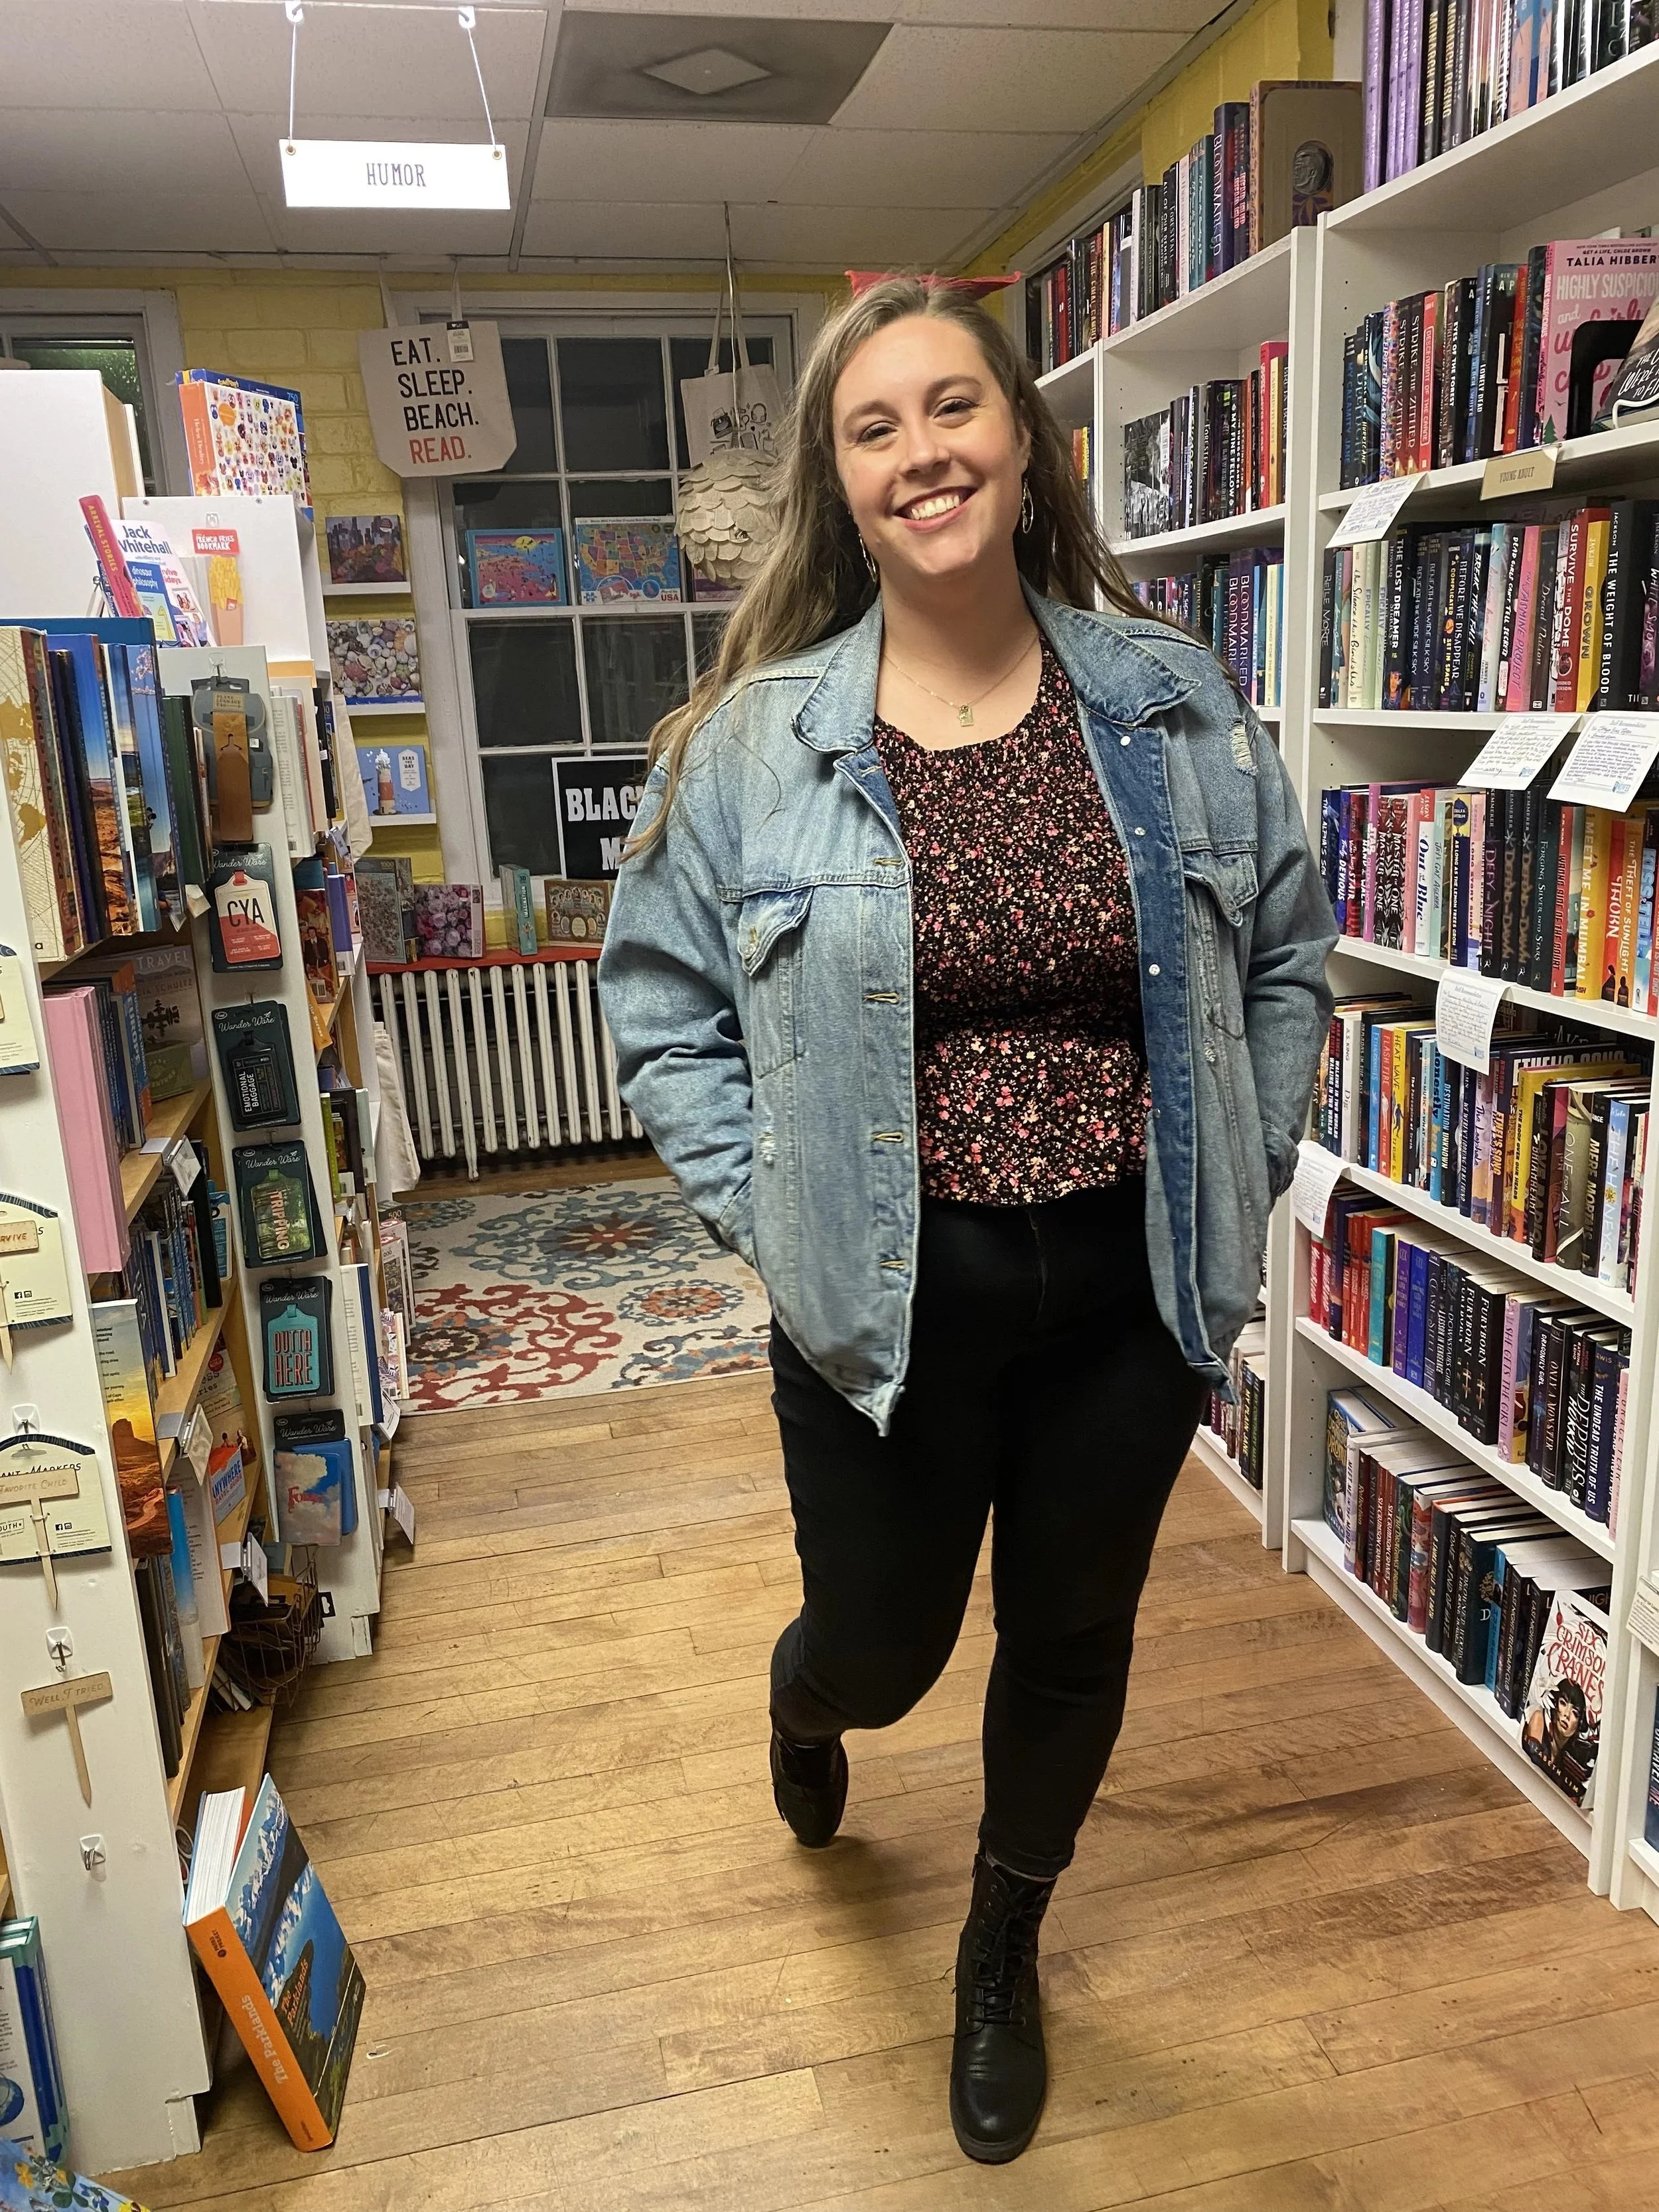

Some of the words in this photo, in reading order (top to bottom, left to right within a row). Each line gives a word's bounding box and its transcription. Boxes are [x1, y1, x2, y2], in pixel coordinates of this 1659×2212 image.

[1427, 11, 1438, 78] MONARCH
[1445, 1, 1457, 72] MONARCH
[1424, 80, 1435, 127] RISING
[1443, 72, 1453, 119] RISING
[366, 163, 426, 186] HUMOR
[1212, 134, 1222, 256] BLOODMARKED
[1567, 257, 1605, 266] TALIA
[1557, 274, 1600, 300] HIGHLY
[1602, 272, 1659, 298] SUSPICIO
[1541, 299, 1550, 337] SUSPICIOUS
[1558, 304, 1581, 324] and
[391, 338, 440, 366] EAT.
[1636, 352, 1652, 368] THE
[398, 370, 472, 398] SLEEP.
[1618, 368, 1653, 397] WE'RE
[1633, 386, 1645, 399] TO
[403, 402, 478, 431] BEACH.
[1231, 411, 1237, 429] MY
[409, 435, 471, 465] READ.
[1500, 469, 1517, 483] YOUNG
[1518, 467, 1534, 479] ADULT
[88, 504, 104, 538] ARRIVAL
[101, 538, 117, 572] STORIES
[123, 526, 151, 539] Jack
[196, 535, 218, 544] FRENCH
[197, 542, 230, 551] BOOKMARK
[1395, 539, 1404, 561] THE
[1566, 524, 1579, 584] SURVIVE
[1609, 551, 1619, 574] THE
[132, 567, 152, 576] dinosaur
[133, 578, 159, 590] philosophy
[1394, 564, 1403, 592] LOST
[1457, 560, 1468, 601] BEFORE
[1473, 552, 1481, 591] BREAK
[1323, 574, 1333, 604] BELLE
[1540, 582, 1551, 621] Dread
[1605, 579, 1617, 628] WEIGHT
[1392, 595, 1402, 648] DREAMER
[1455, 604, 1464, 619] WE
[1561, 606, 1572, 648] DOME
[1581, 586, 1594, 659] GROWN
[1239, 575, 1250, 687] BLOODMARKED
[1321, 609, 1332, 647] MORTE
[1468, 618, 1477, 645] FALL
[1603, 632, 1613, 648] OF
[1451, 622, 1463, 679] DISAPPEAR
[1537, 625, 1548, 665] Nation
[1600, 653, 1611, 694] BLOOD
[1377, 832, 1386, 875] MASTER
[1391, 834, 1400, 877] MASTER
[1419, 838, 1430, 871] Out
[1583, 824, 1594, 863] MEET
[1484, 849, 1498, 891] DEFY
[1538, 840, 1548, 880] FORGING
[1640, 848, 1656, 899] KISS
[1337, 859, 1347, 901] DEVIOUS
[1581, 869, 1591, 891] ME
[1624, 859, 1637, 900] THEFT
[227, 898, 265, 927] CYA
[520, 886, 528, 918] IMAGINATION
[1375, 885, 1384, 913] ONE
[1390, 887, 1400, 914] ONE
[1416, 883, 1428, 921] Blue
[1537, 884, 1546, 913] SILVER
[1580, 897, 1591, 915] IN
[1606, 875, 1623, 938] THORN
[1626, 902, 1632, 914] OF
[1483, 899, 1499, 955] NIGHT
[1638, 901, 1653, 947] TELL
[137, 950, 190, 970] TRAVEL
[1534, 934, 1543, 962] STARS
[1577, 919, 1590, 980] MUMBAI
[1619, 916, 1631, 974] SUNLIGHT
[155, 978, 194, 994] SCHULTZ
[126, 995, 141, 1065] EUROPE
[219, 1019, 252, 1031] Wander
[252, 1016, 275, 1025] Ware
[1382, 1035, 1391, 1067] FLASH
[239, 1071, 252, 1112] EMOTIONAL
[247, 1073, 259, 1107] BAGGAGE
[1381, 1068, 1390, 1086] FIRE
[1442, 1083, 1451, 1131] DESTINATION
[1475, 1104, 1485, 1123] The
[1494, 1112, 1505, 1147] ETHEL'S
[246, 1157, 278, 1169] Wander
[279, 1154, 301, 1163] Ware
[1441, 1132, 1451, 1169] UNKNOWN
[1473, 1125, 1484, 1167] Loophole
[1493, 1149, 1502, 1175] SONG
[1561, 1131, 1576, 1175] ONE
[270, 1190, 289, 1250] TRIPPING
[1559, 1191, 1571, 1229] ALL
[265, 1290, 296, 1303] Wander
[297, 1289, 319, 1299] Ware
[1463, 1287, 1475, 1357] FURYBORN
[1478, 1296, 1490, 1367] FURYBORN
[1504, 1327, 1514, 1349] SHE
[273, 1329, 312, 1355] OUTTA
[1446, 1312, 1455, 1366] DOWNSTAIRS
[275, 1352, 313, 1387] HERE
[1502, 1350, 1512, 1377] GETS
[1245, 1388, 1251, 1400] MY
[1501, 1379, 1511, 1401] THE
[1595, 1384, 1605, 1401] THE
[1499, 1402, 1510, 1427] GIRL
[1593, 1403, 1603, 1441] UNDEAD
[280, 1426, 313, 1438] Wander
[314, 1424, 336, 1432] Ware
[1590, 1443, 1601, 1475] TRUTH
[1587, 1490, 1596, 1505] US
[1589, 1476, 1597, 1489] OF
[1576, 1622, 1599, 1650] SIX
[76, 1683, 104, 1696] TRIED
[1548, 1642, 1604, 1715] CRANES
[1523, 1733, 1562, 1777] ELIZABETH
[1564, 1777, 1579, 1794] LIM
[281, 1989, 292, 2015] The
[287, 1958, 309, 2026] Parklands
[241, 1995, 277, 2057] Parklands
[271, 2054, 289, 2085] The
